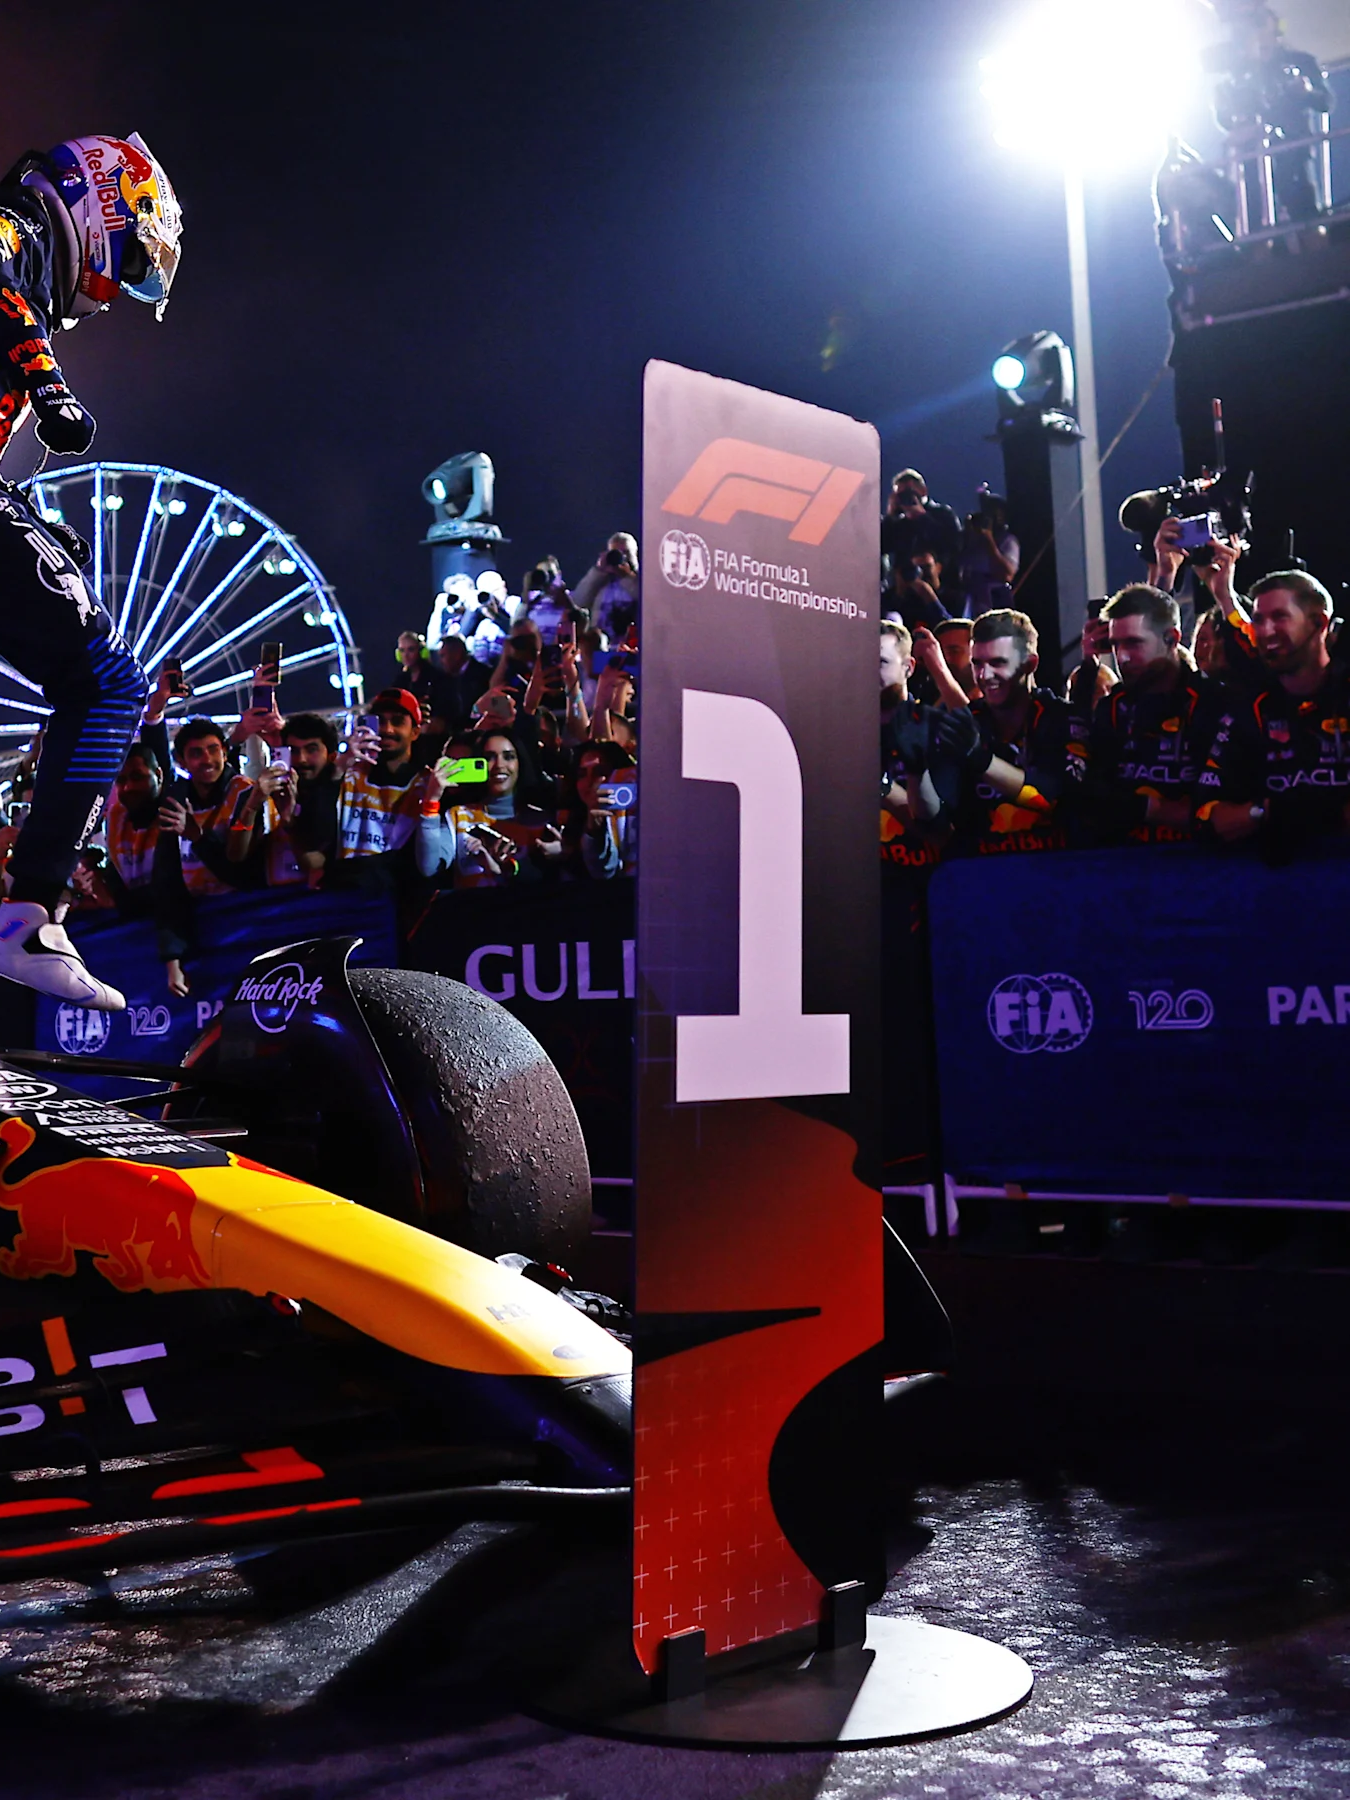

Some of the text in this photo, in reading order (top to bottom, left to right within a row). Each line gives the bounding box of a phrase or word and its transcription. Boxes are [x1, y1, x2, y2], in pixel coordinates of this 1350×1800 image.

[82, 148, 127, 231] Red Bull
[714, 548, 810, 587] FIA Formula 1
[714, 571, 759, 598] World
[760, 581, 858, 619] Championship
[676, 688, 851, 1104] 1
[234, 976, 324, 1006] Hard Rock
[1128, 988, 1215, 1031] 120
